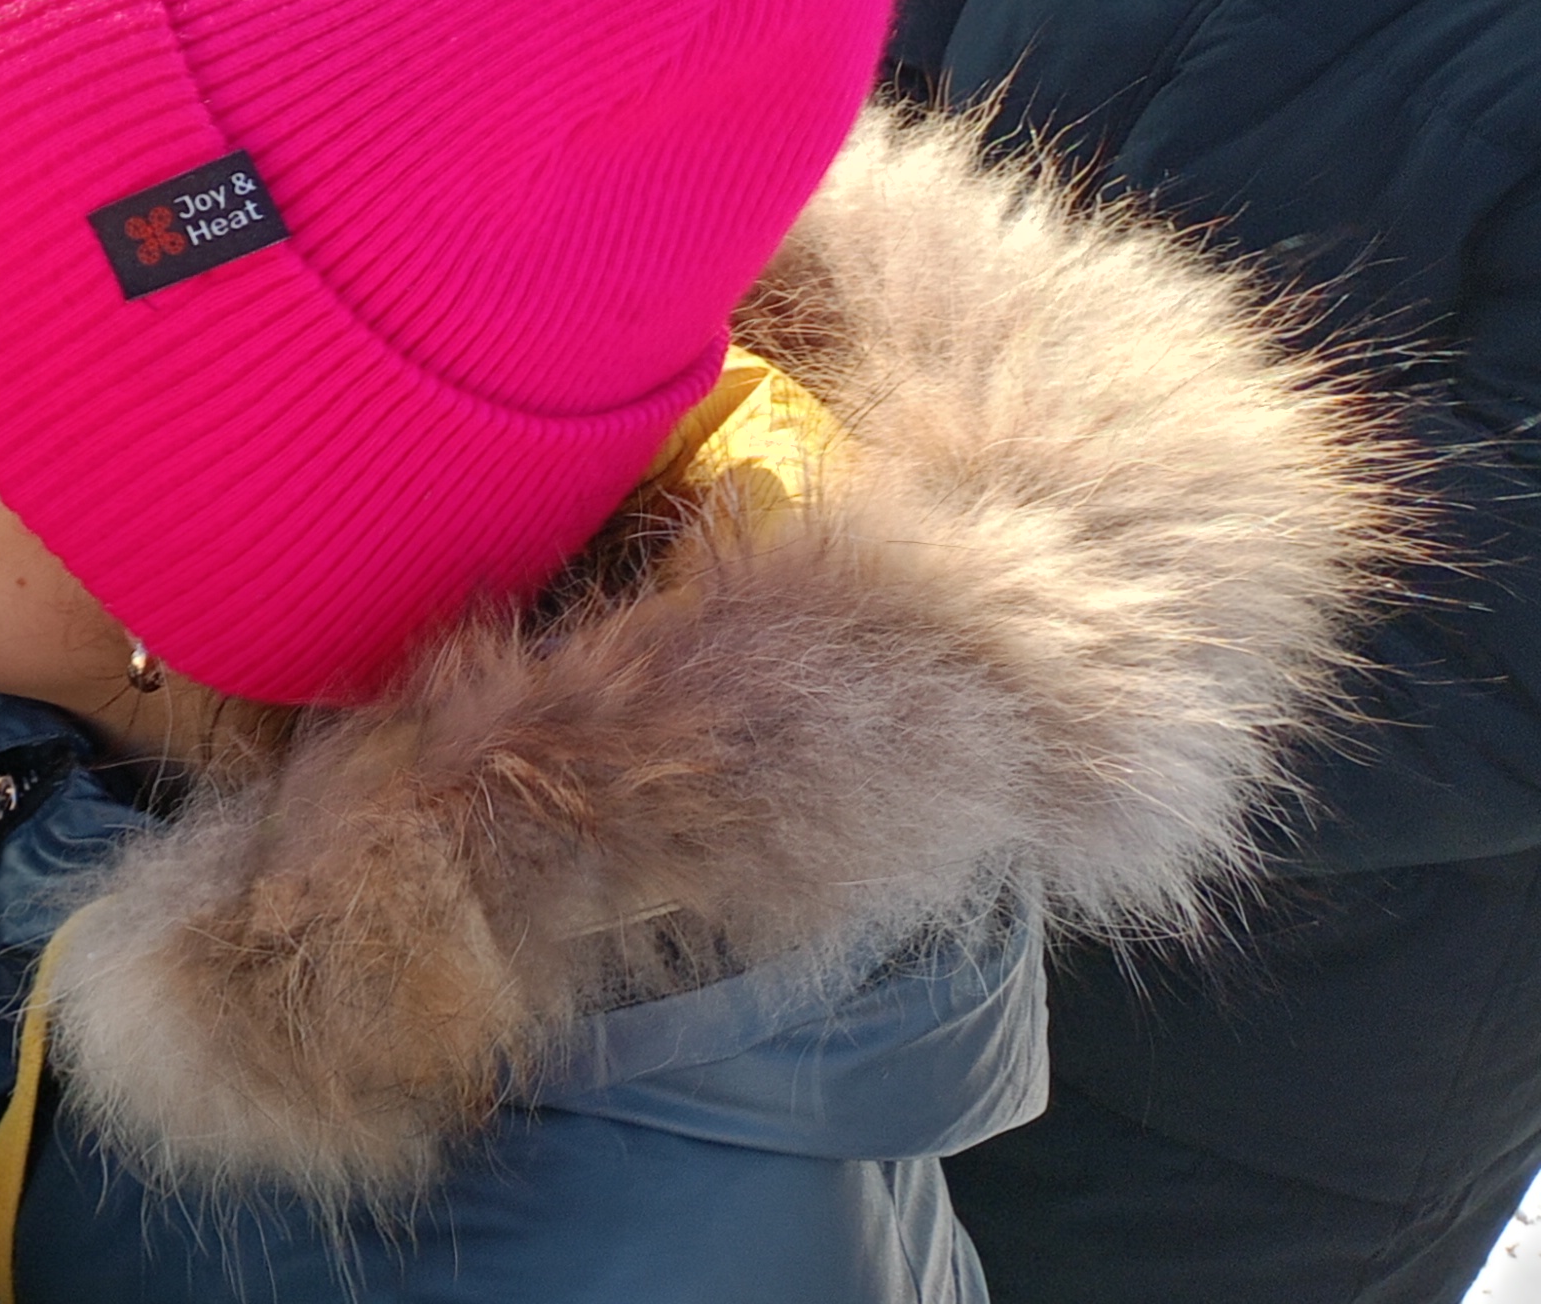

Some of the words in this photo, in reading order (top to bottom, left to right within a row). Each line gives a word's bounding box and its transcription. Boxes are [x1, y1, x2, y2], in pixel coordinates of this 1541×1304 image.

[173, 184, 226, 219] Joy
[230, 172, 257, 195] &
[185, 199, 264, 246] Heat
